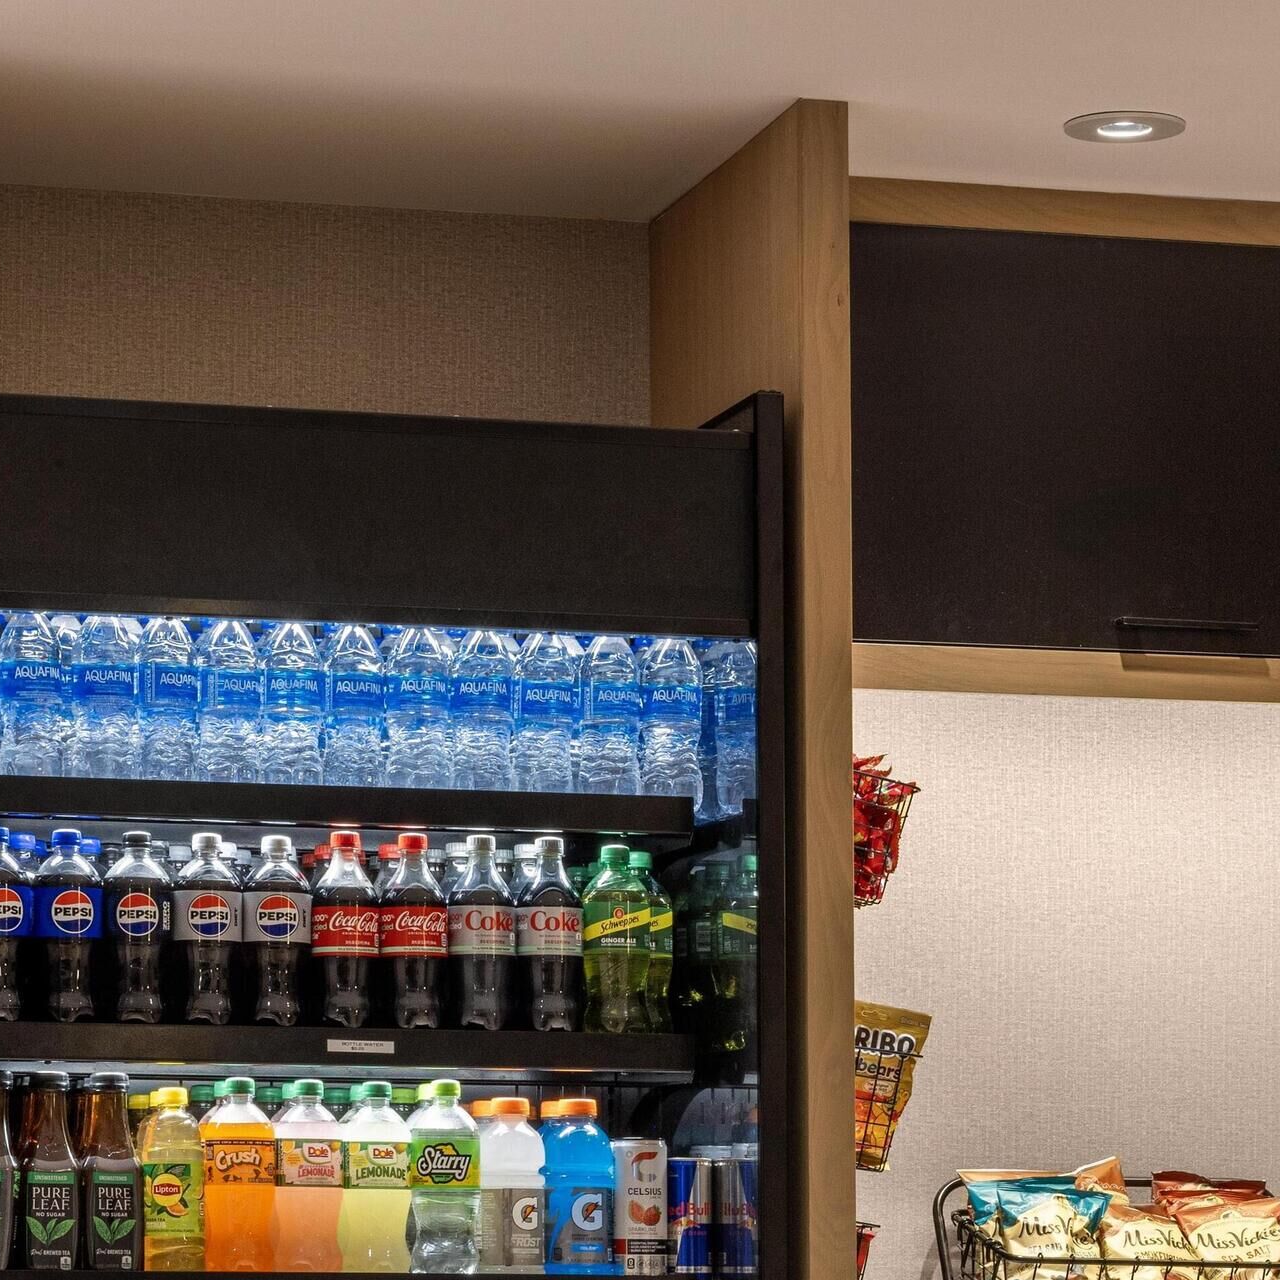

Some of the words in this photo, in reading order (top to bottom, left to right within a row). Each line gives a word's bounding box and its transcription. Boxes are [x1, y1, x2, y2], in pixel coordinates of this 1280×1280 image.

[15, 665, 60, 680] AQUAFINA
[84, 669, 132, 684] AQUAFINA
[270, 678, 318, 693] AQUAFINA
[336, 680, 381, 695] AQUAFINA
[400, 679, 447, 694] AQUAFINA
[459, 681, 507, 695] AQUAFINA
[525, 689, 571, 702] AQUAFINA
[652, 690, 698, 702] AQUAFINA
[54, 906, 92, 917] PEPSI
[118, 909, 157, 919] PEPSI
[190, 910, 228, 921] PEPSI
[258, 911, 297, 922] PEPSI
[464, 910, 513, 932] Coke
[530, 910, 580, 932] Coke
[599, 915, 640, 934] Schweppes
[854, 1025, 916, 1059] RIBO
[308, 1146, 329, 1155] Dole
[373, 1148, 394, 1157] Dole
[215, 1147, 261, 1171] Crush
[418, 1146, 471, 1177] Starry
[298, 1166, 335, 1178] LEMONADE
[356, 1165, 406, 1180] LEMONADE
[32, 1187, 70, 1199] PURE
[98, 1187, 131, 1199] PURE
[155, 1186, 179, 1194] Lipton
[627, 1187, 662, 1196] CELSIUS
[32, 1199, 69, 1211] LEAF
[98, 1199, 131, 1211] LEAF
[571, 1193, 603, 1231] G
[512, 1196, 538, 1231] G
[1019, 1216, 1060, 1239] Miss
[1123, 1229, 1163, 1248] Miss
[1194, 1232, 1234, 1249] Miss
[1246, 1245, 1271, 1260] SALT
